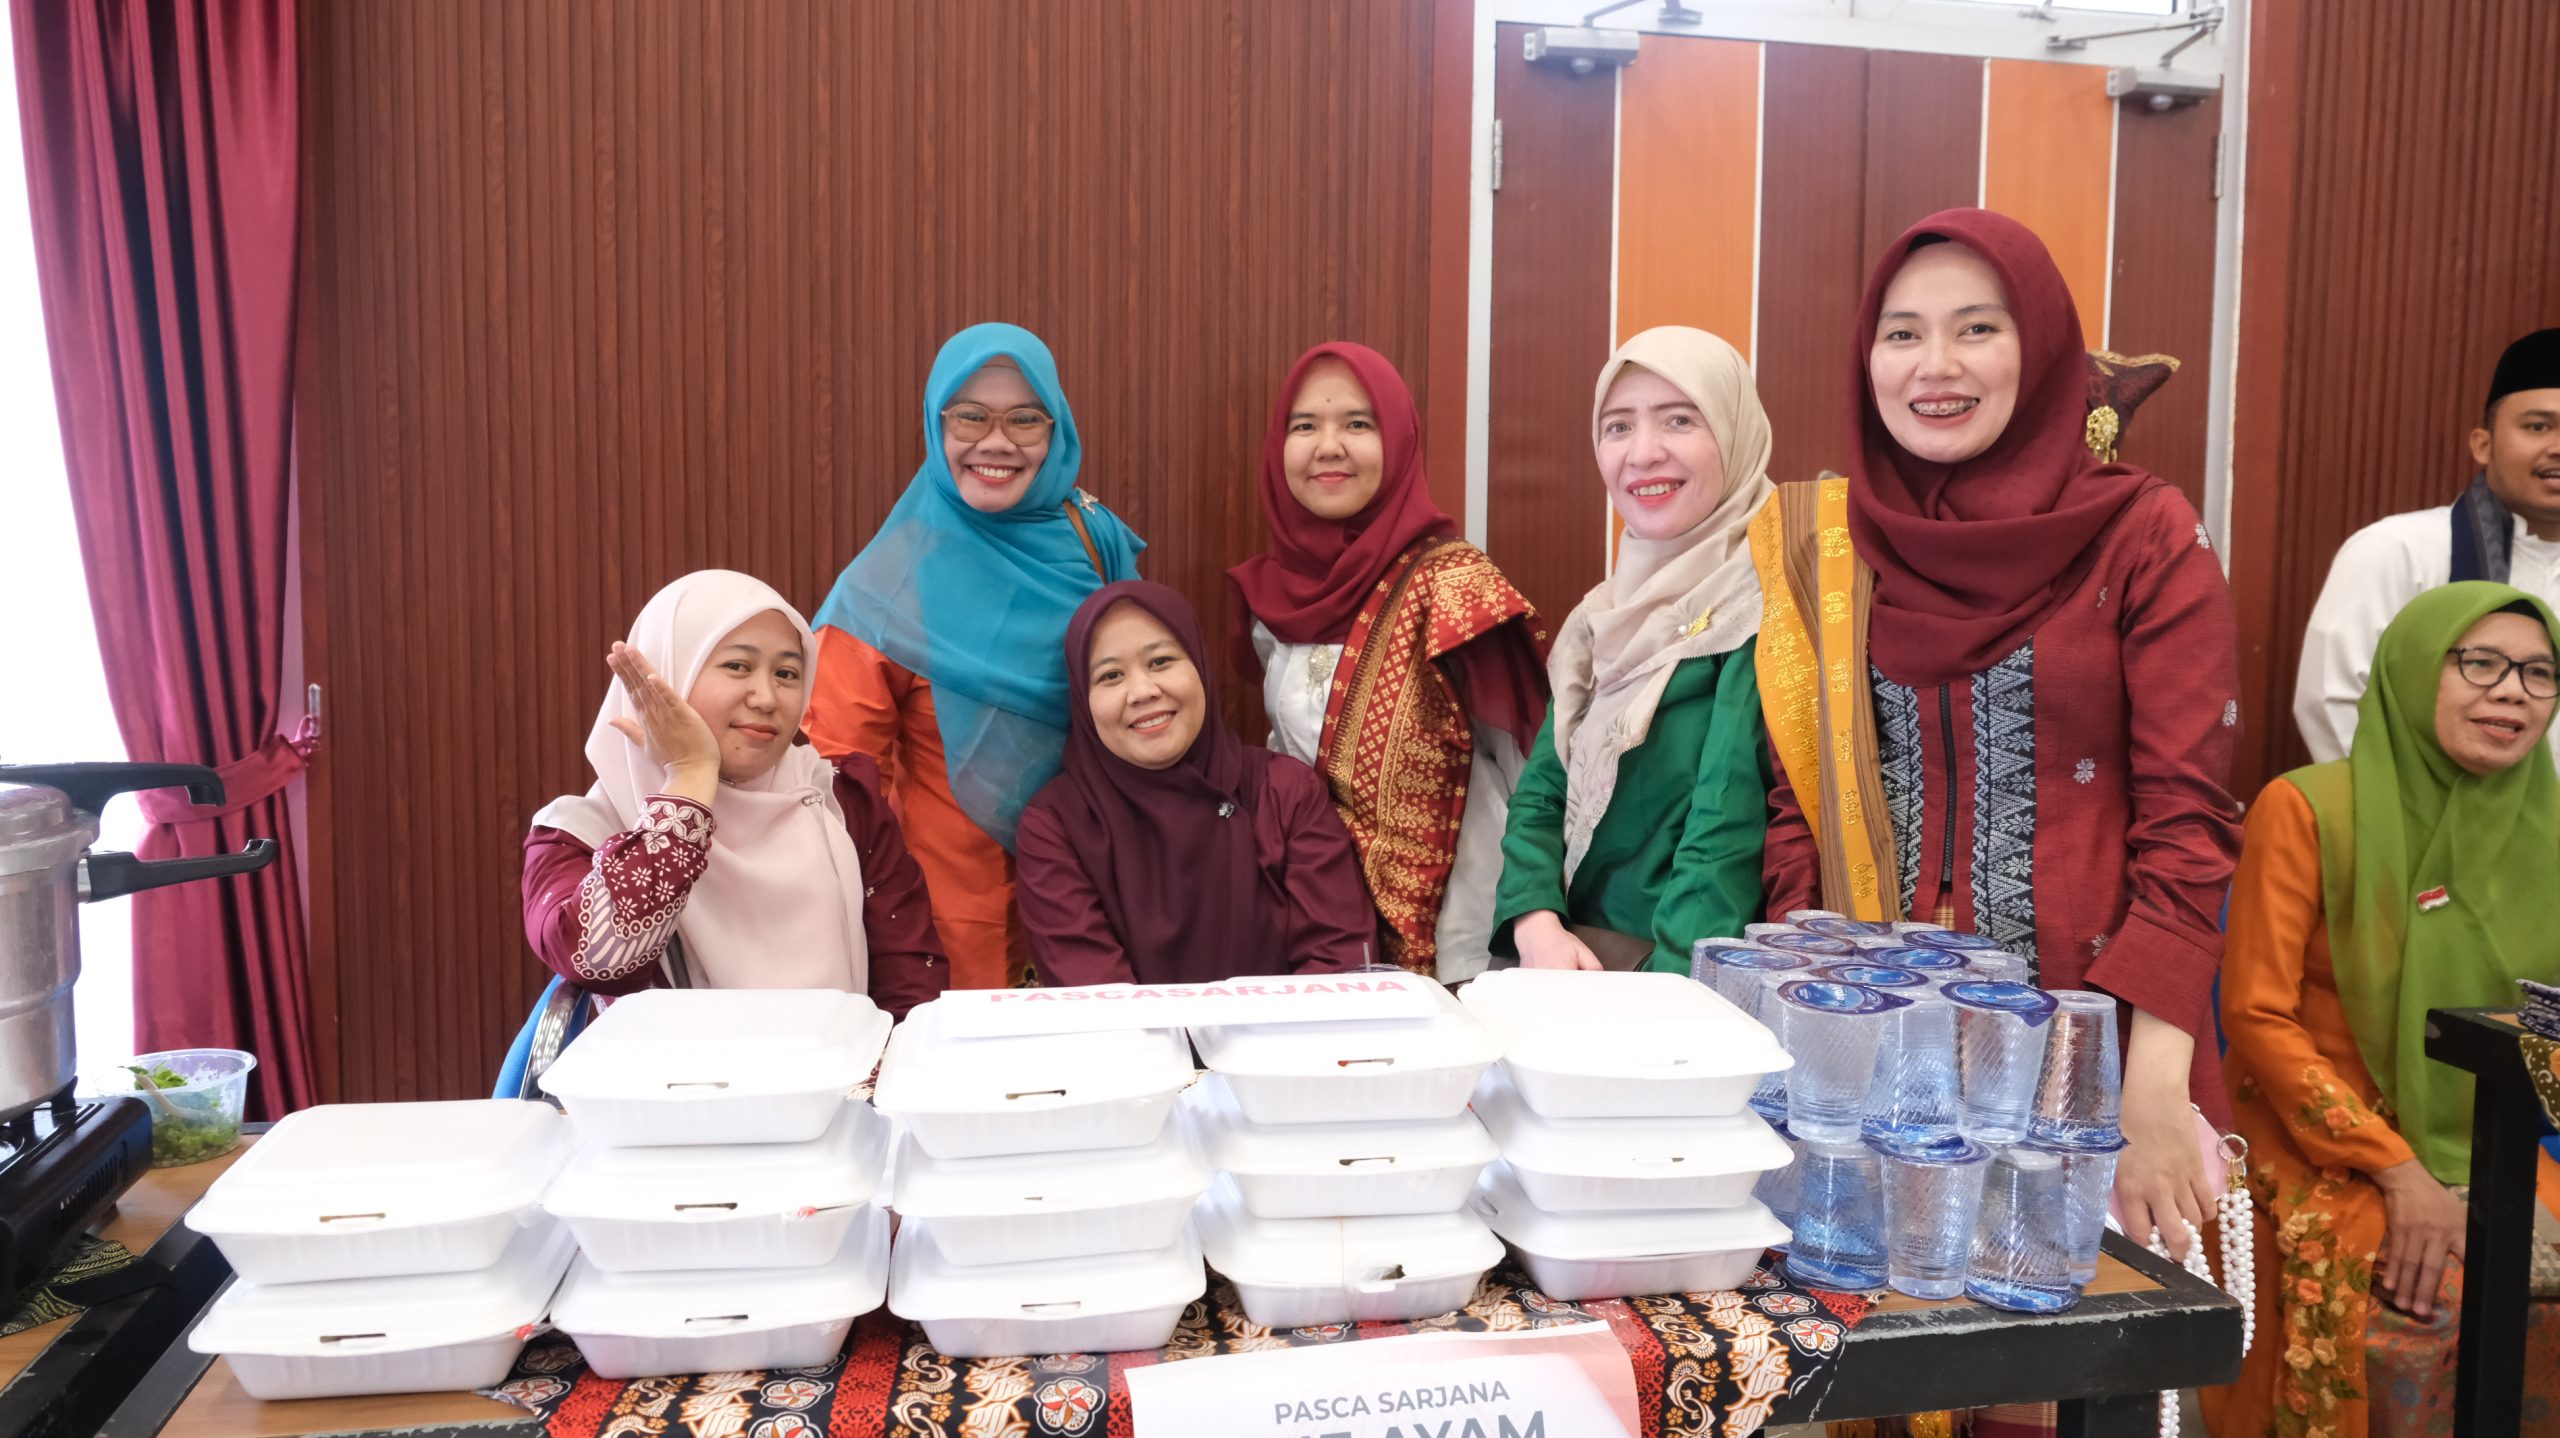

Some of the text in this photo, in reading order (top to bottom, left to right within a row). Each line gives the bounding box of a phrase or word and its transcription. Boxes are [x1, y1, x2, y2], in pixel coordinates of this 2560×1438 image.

[989, 980, 1408, 1003] PASCASARJANA
[1274, 1380, 1511, 1425] PASCA SARJANA
[1384, 1410, 1546, 1438] AM
